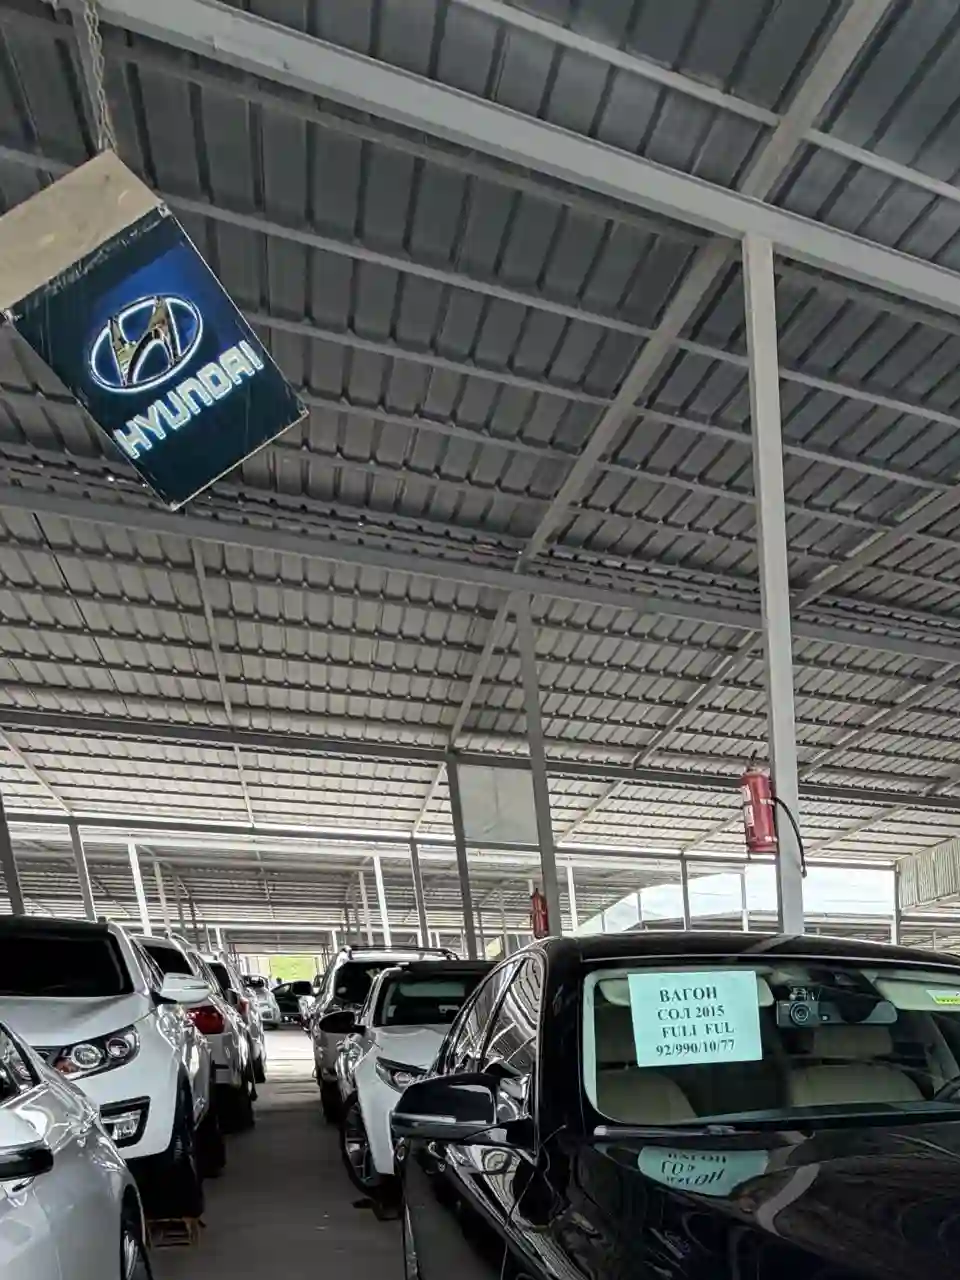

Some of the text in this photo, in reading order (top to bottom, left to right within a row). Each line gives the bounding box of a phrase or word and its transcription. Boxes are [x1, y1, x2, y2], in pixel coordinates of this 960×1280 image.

[112, 339, 264, 459] HYUNDAI
[659, 986, 718, 1003] ВАГОН
[657, 1005, 725, 1021] СОЛ 2015
[705, 1022, 735, 1035] FUL
[656, 1039, 735, 1057] 92/990/10/77
